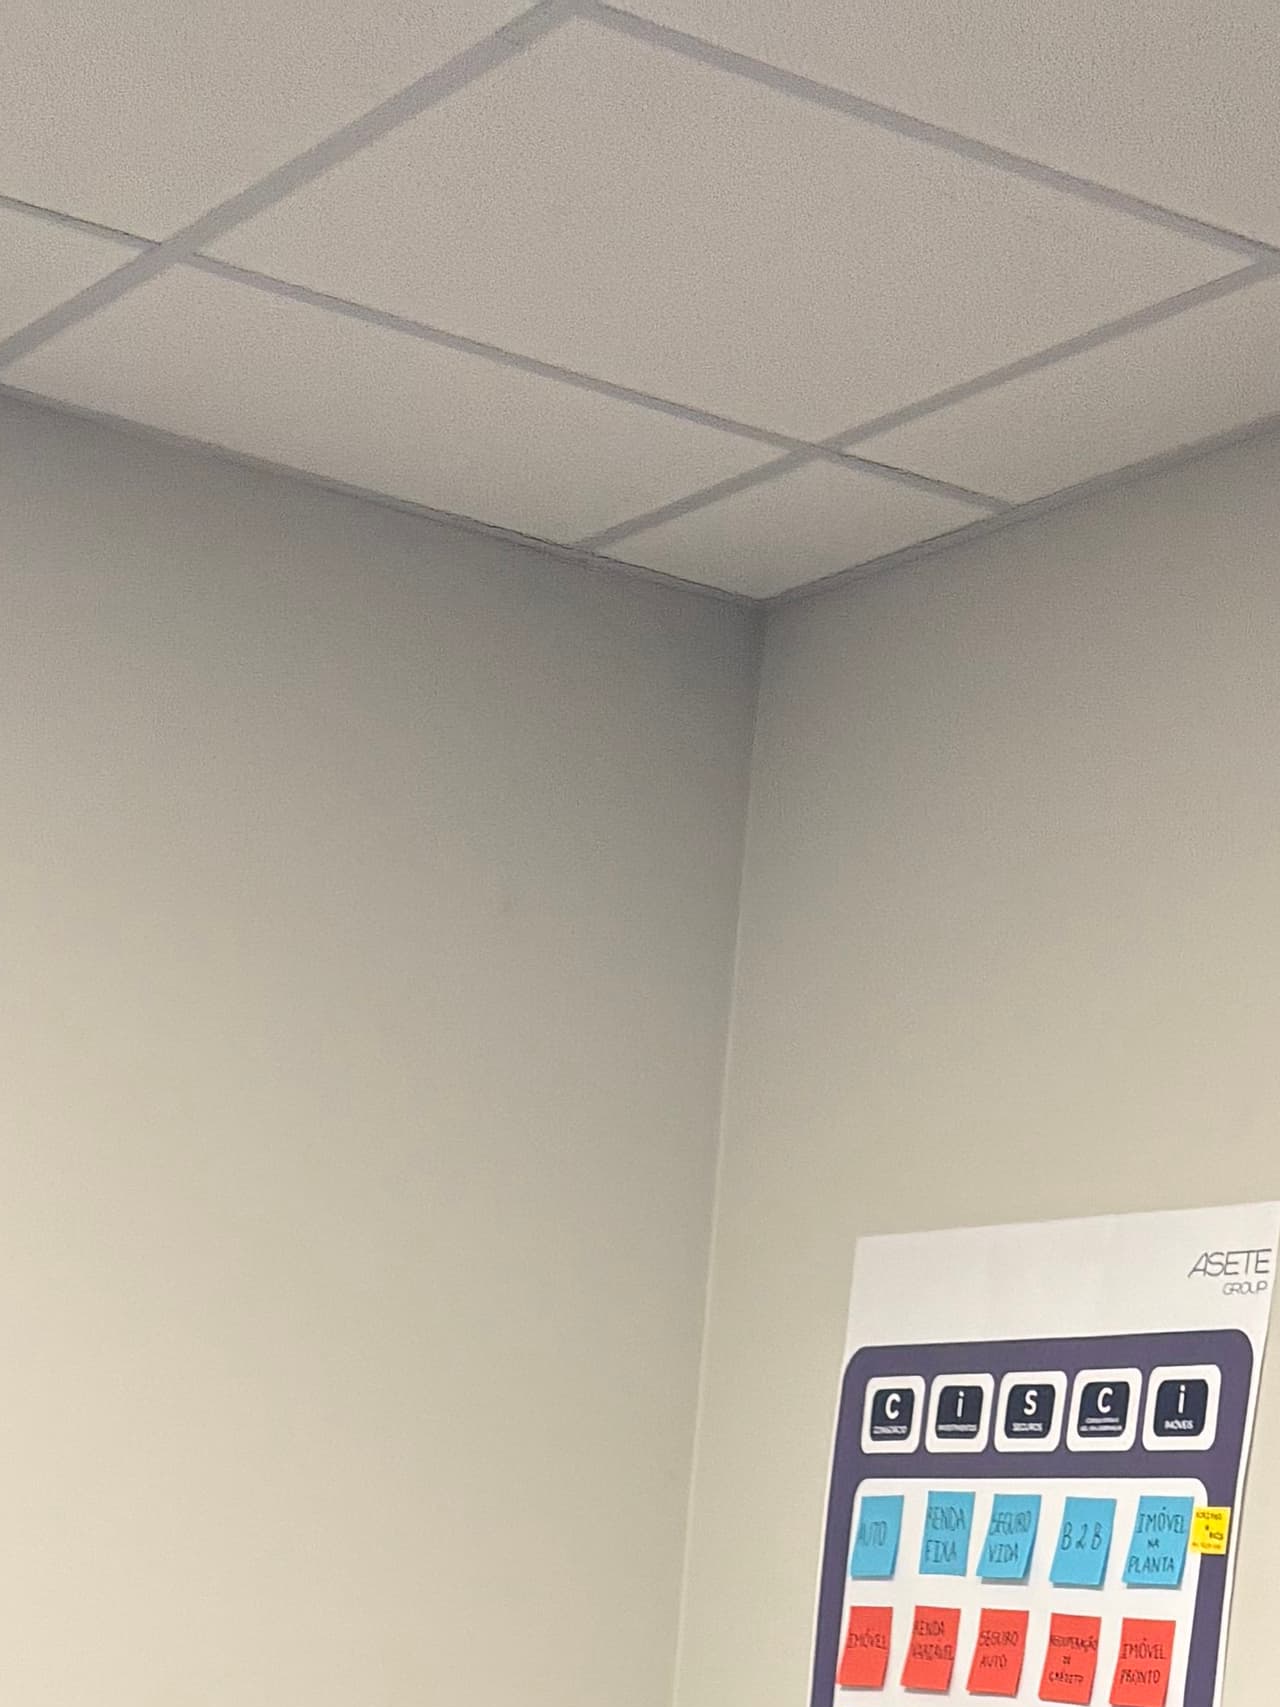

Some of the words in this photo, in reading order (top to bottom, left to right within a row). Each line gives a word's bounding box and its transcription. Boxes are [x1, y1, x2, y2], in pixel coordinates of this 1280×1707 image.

[1187, 1248, 1272, 1278] ASETE
[1222, 1280, 1269, 1296] GROUP
[885, 1393, 901, 1419] C
[1023, 1389, 1038, 1416] S
[1097, 1387, 1114, 1413] C
[927, 1505, 966, 1532] RENDA
[989, 1510, 1032, 1536] SEGURO
[1136, 1506, 1185, 1534] IMÓVEL
[859, 1520, 888, 1547] AUTO
[925, 1539, 957, 1564] FIXA
[988, 1542, 1019, 1564] VIDA
[1127, 1556, 1175, 1574] PLANTA
[847, 1628, 887, 1651] IMÓVEL
[913, 1619, 945, 1637] RENDA
[979, 1630, 1018, 1648] SEGURO
[1121, 1638, 1167, 1660] IMÓVEL
[979, 1654, 1008, 1669] AUTO
[1120, 1668, 1161, 1686] PRONTO
